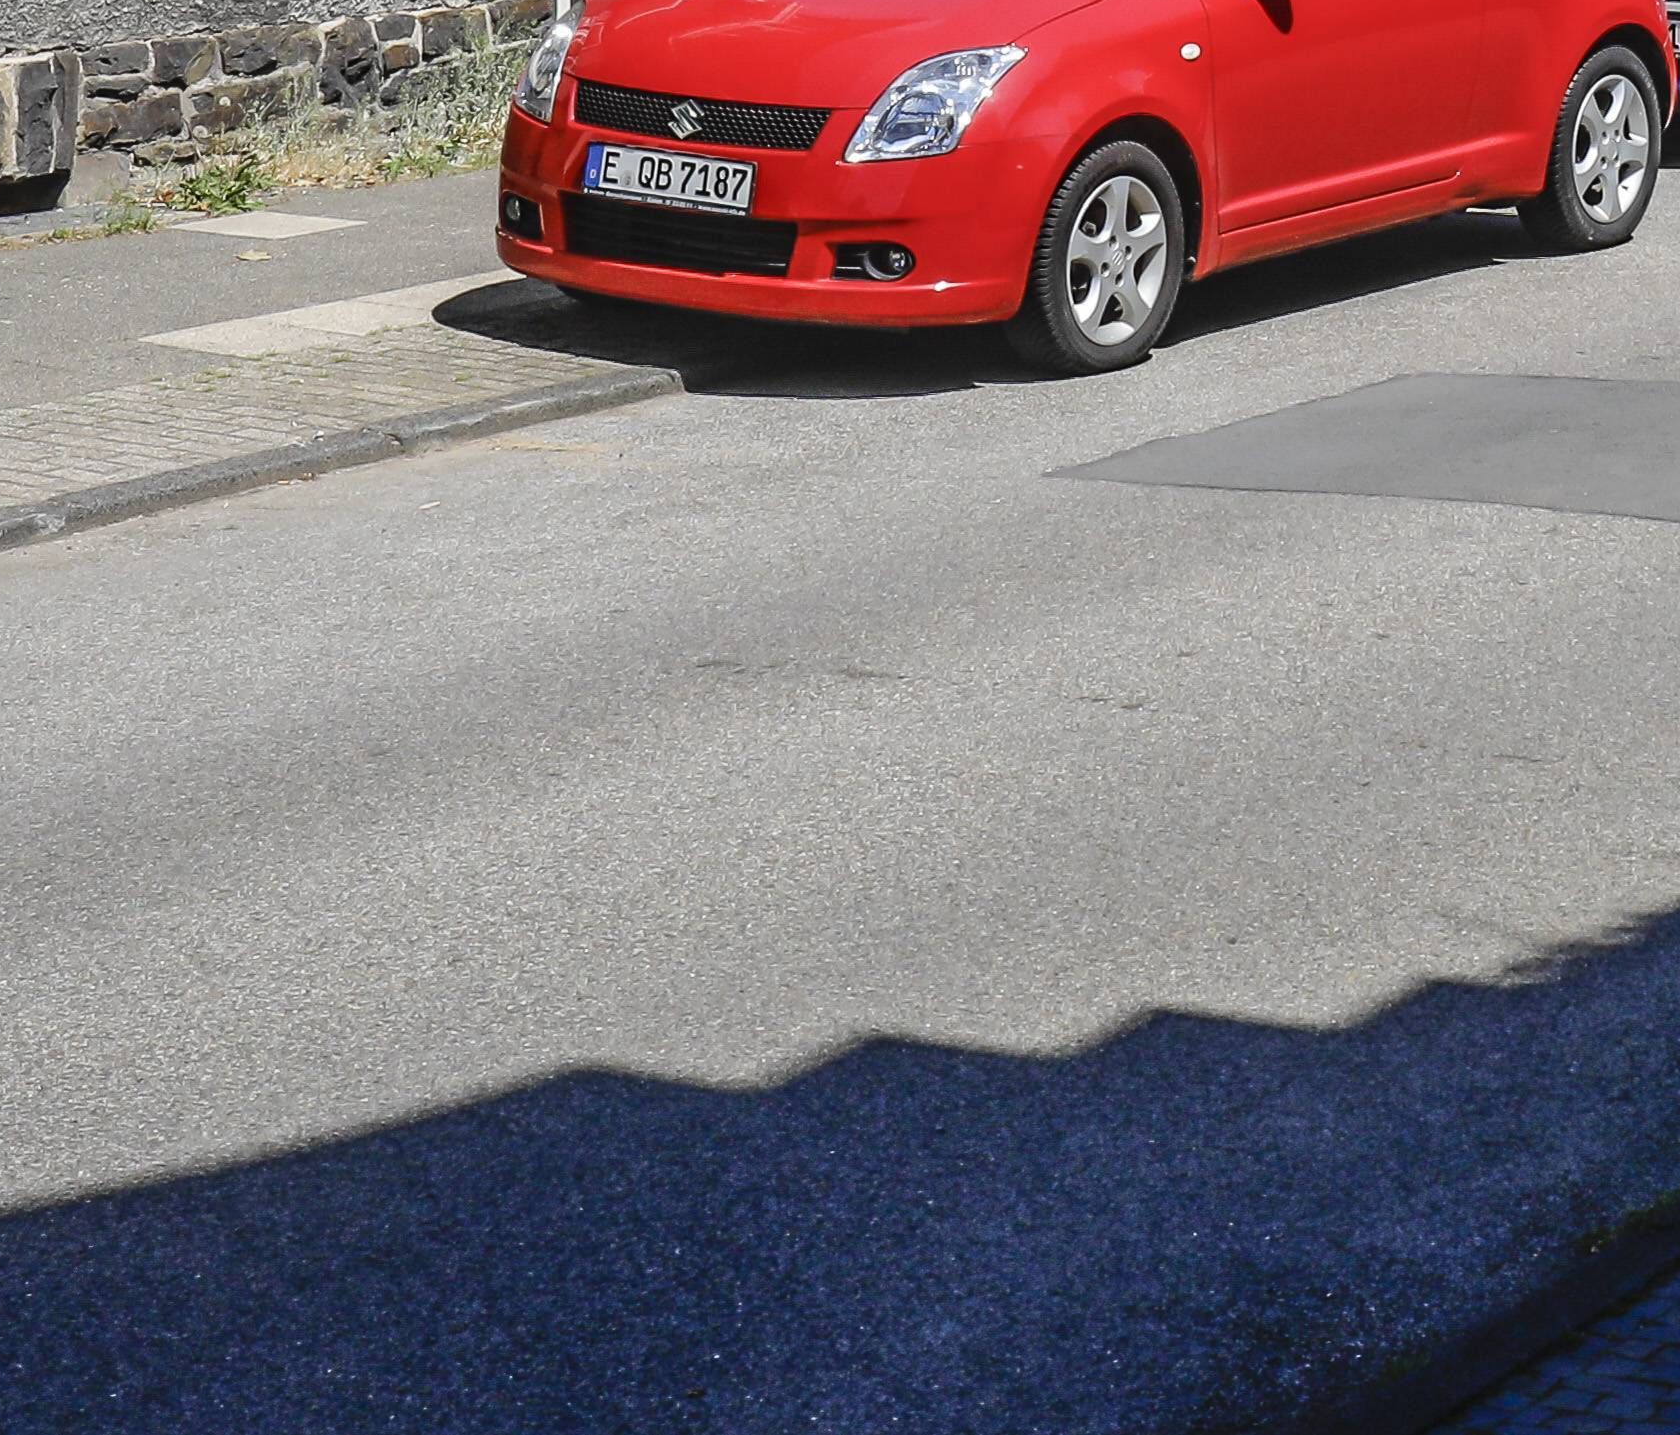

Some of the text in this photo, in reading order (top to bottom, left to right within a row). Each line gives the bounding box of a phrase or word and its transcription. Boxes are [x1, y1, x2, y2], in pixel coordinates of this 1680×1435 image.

[601, 151, 621, 184] E
[637, 156, 673, 191] QB
[680, 161, 748, 202] 7187
